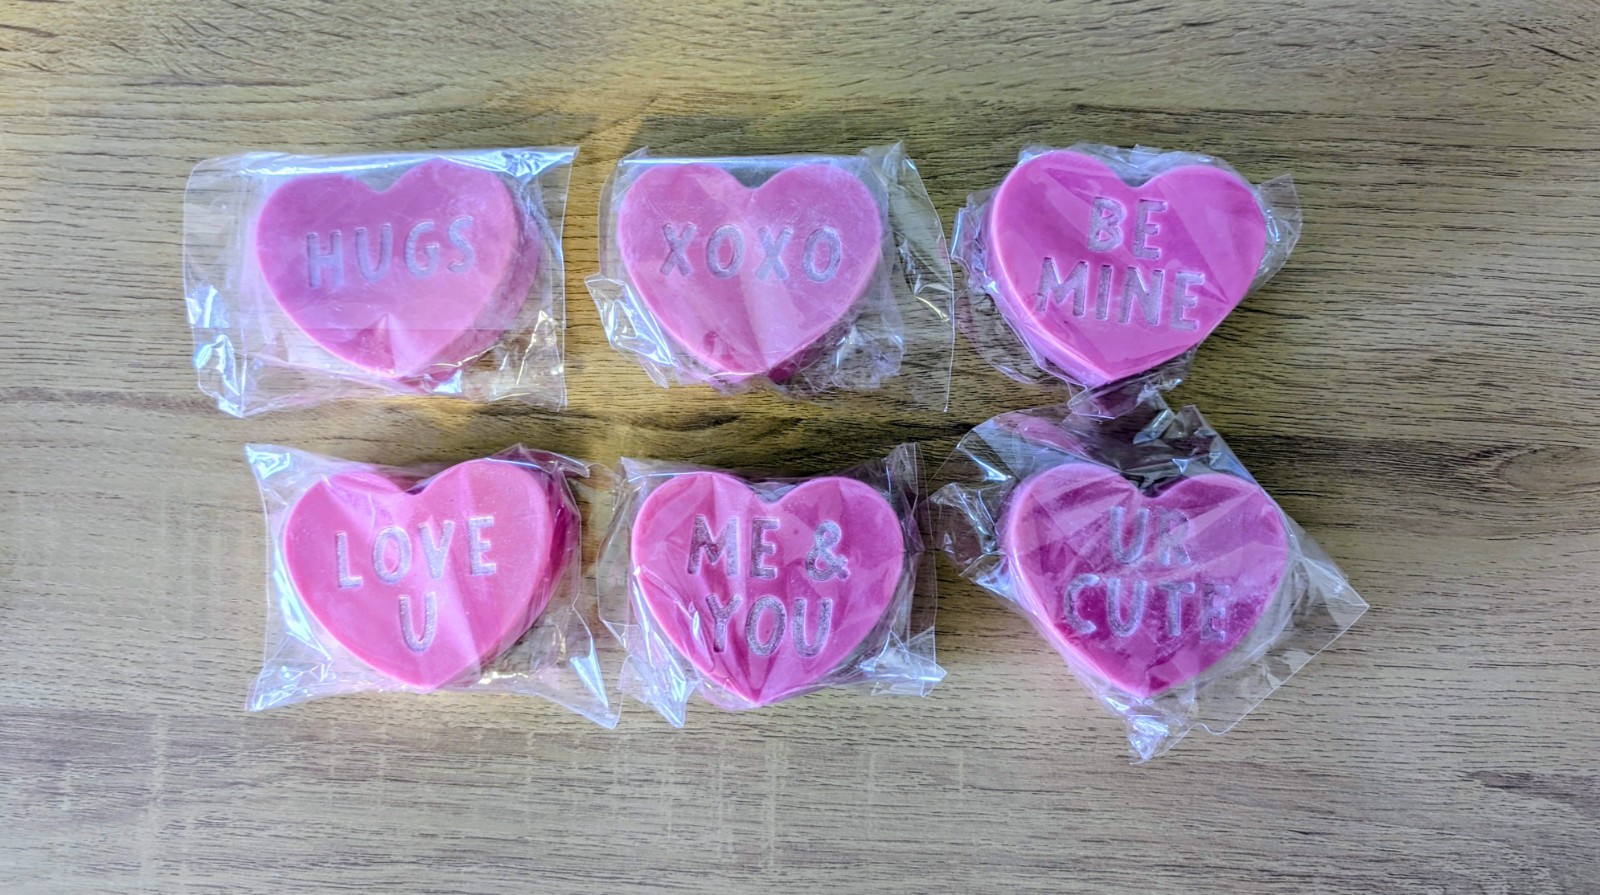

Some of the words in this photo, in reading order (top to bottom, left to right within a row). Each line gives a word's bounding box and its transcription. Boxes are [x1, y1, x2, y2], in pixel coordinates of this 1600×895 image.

[306, 215, 476, 289] HUGS
[660, 221, 842, 283] XOXO
[1087, 196, 1168, 260] BE
[1035, 256, 1205, 332] MINE
[335, 514, 496, 589] LOVE
[687, 514, 780, 579] ME
[805, 519, 850, 582] &
[1110, 506, 1192, 565] UR
[399, 591, 438, 653] U
[706, 593, 833, 658] YOU
[1063, 573, 1231, 642] CUTE
